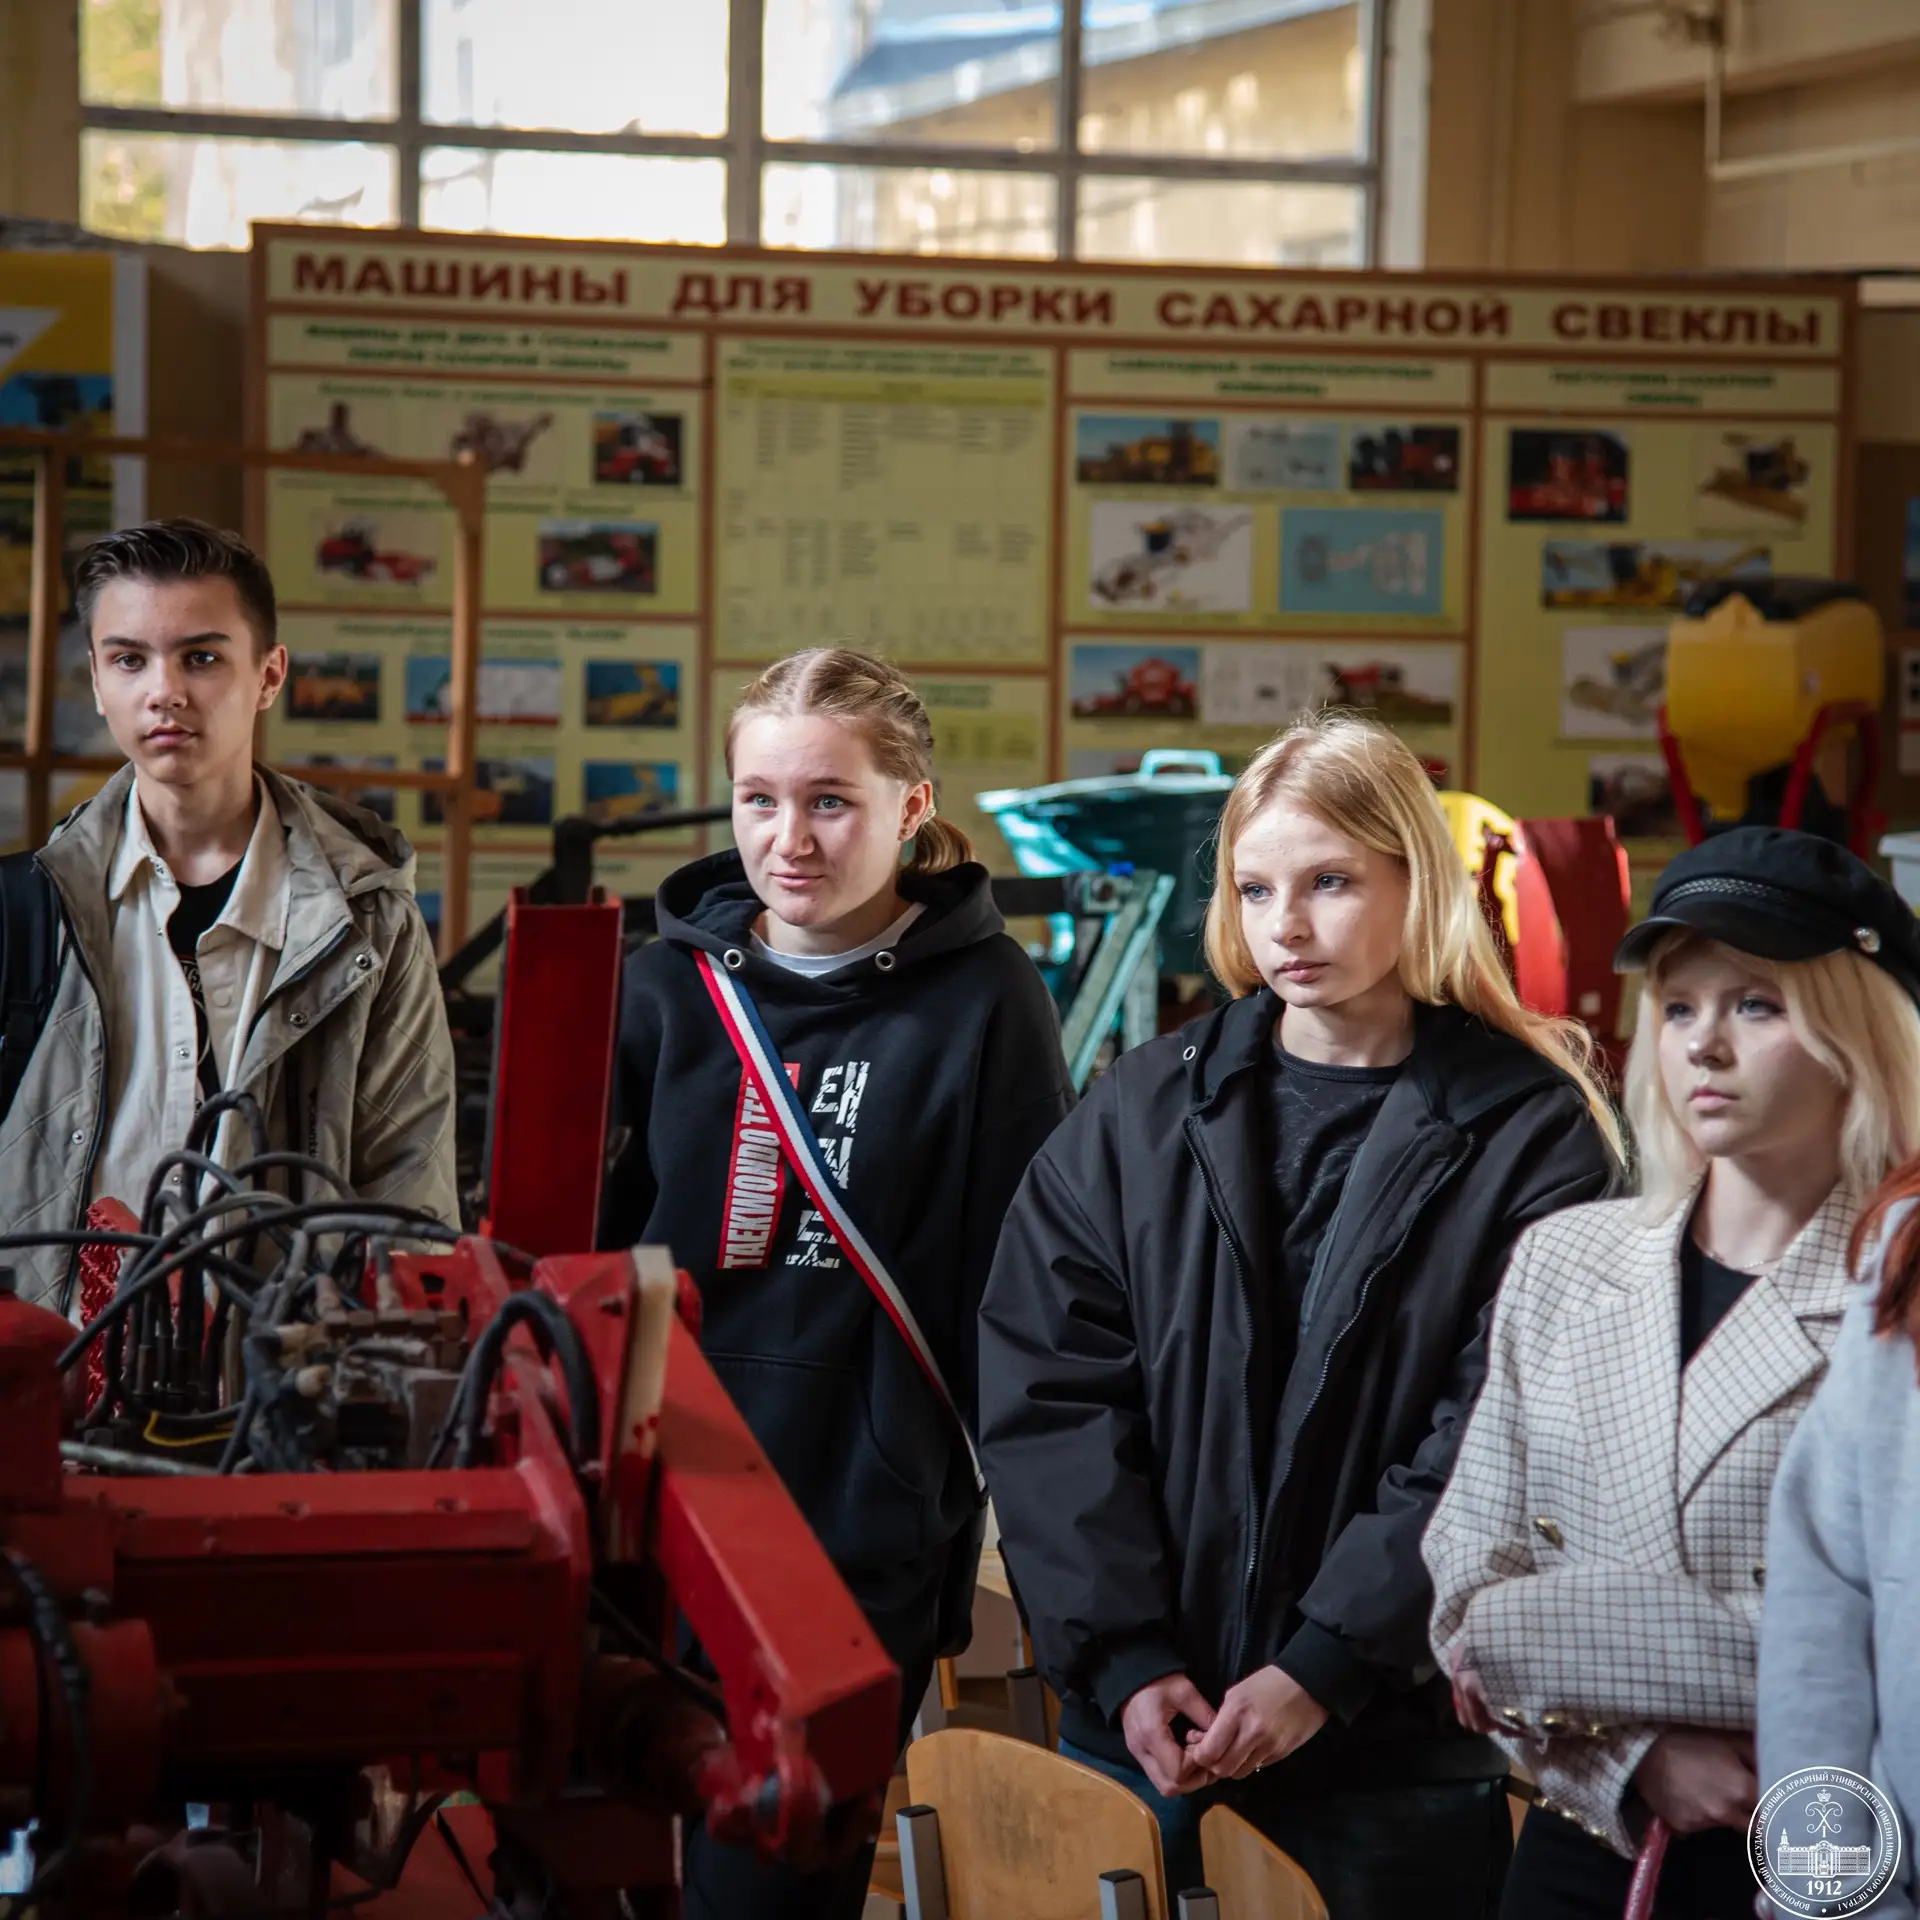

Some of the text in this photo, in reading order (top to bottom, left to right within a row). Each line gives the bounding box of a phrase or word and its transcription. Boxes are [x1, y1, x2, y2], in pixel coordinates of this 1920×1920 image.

[295, 253, 1821, 347] МАШИНЫ ДЛЯ УБОРКИ САХАРНОЙ СВЕКЛЫ
[723, 1129, 780, 1268] TAEKWONDO
